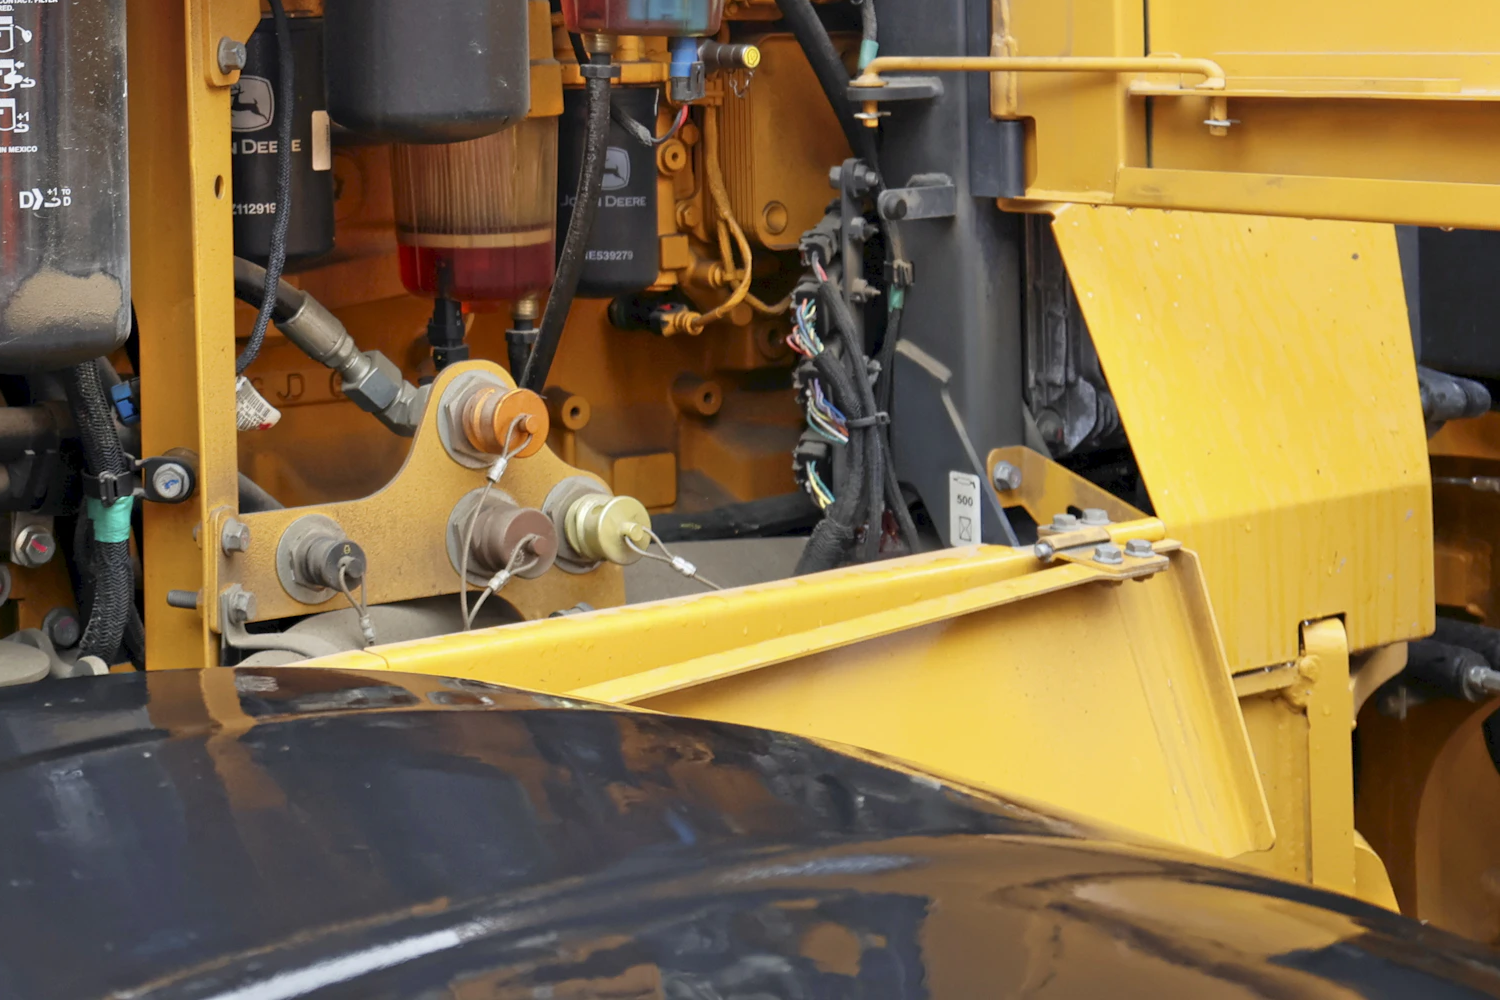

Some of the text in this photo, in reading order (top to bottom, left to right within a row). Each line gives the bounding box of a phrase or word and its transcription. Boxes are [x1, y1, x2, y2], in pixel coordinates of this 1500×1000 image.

[241, 139, 301, 154] DEEE
[61, 188, 71, 196] TO
[605, 196, 646, 207] DEERE
[957, 494, 973, 507] 500
